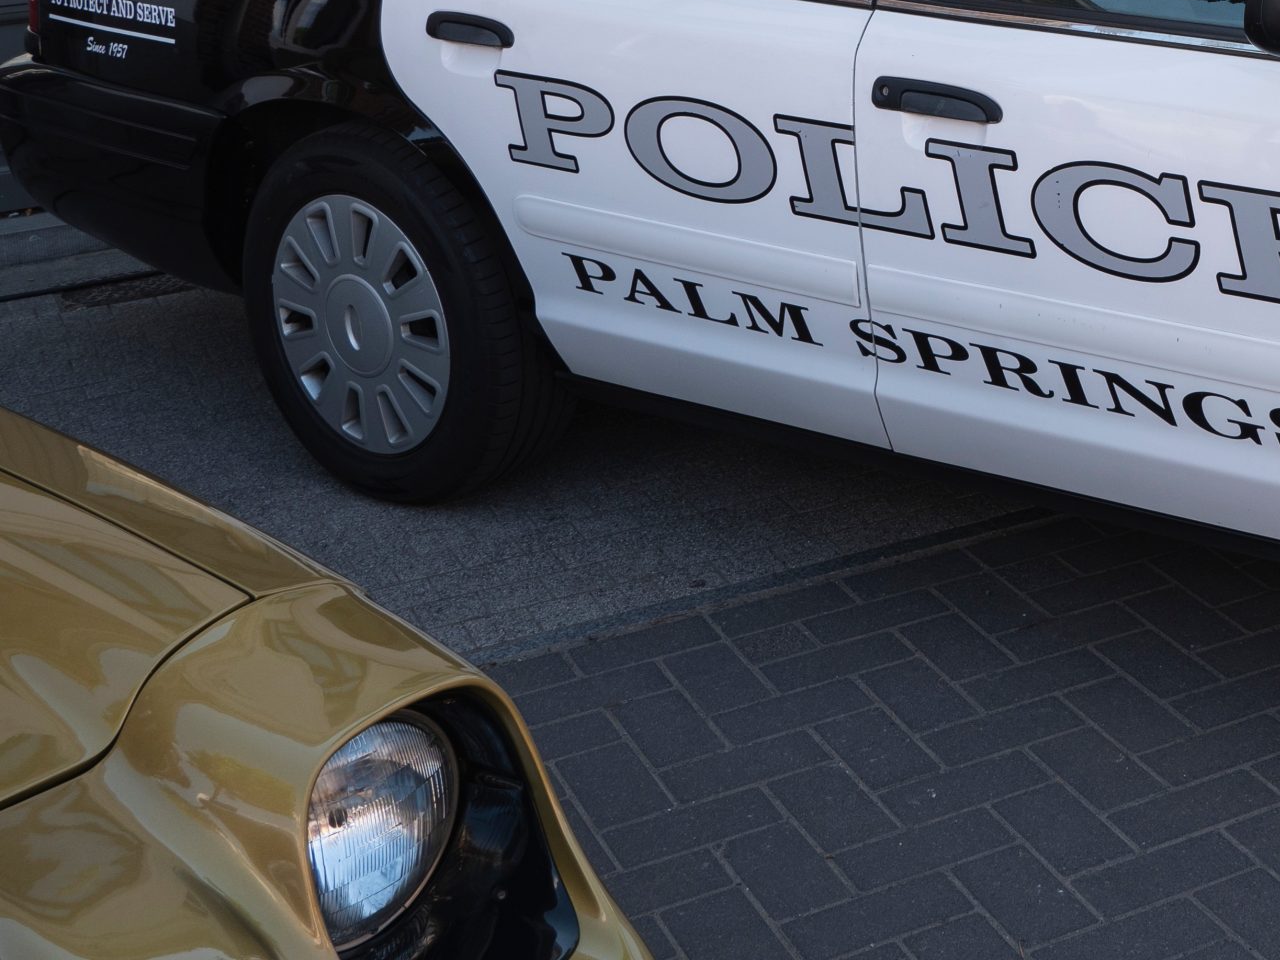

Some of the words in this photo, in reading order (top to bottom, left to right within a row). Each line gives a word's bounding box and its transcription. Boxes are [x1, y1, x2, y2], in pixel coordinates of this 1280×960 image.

[136, 2, 176, 27] SERVE
[86, 36, 106, 54] Since
[108, 42, 128, 59] 1957
[561, 251, 823, 347] PALM
